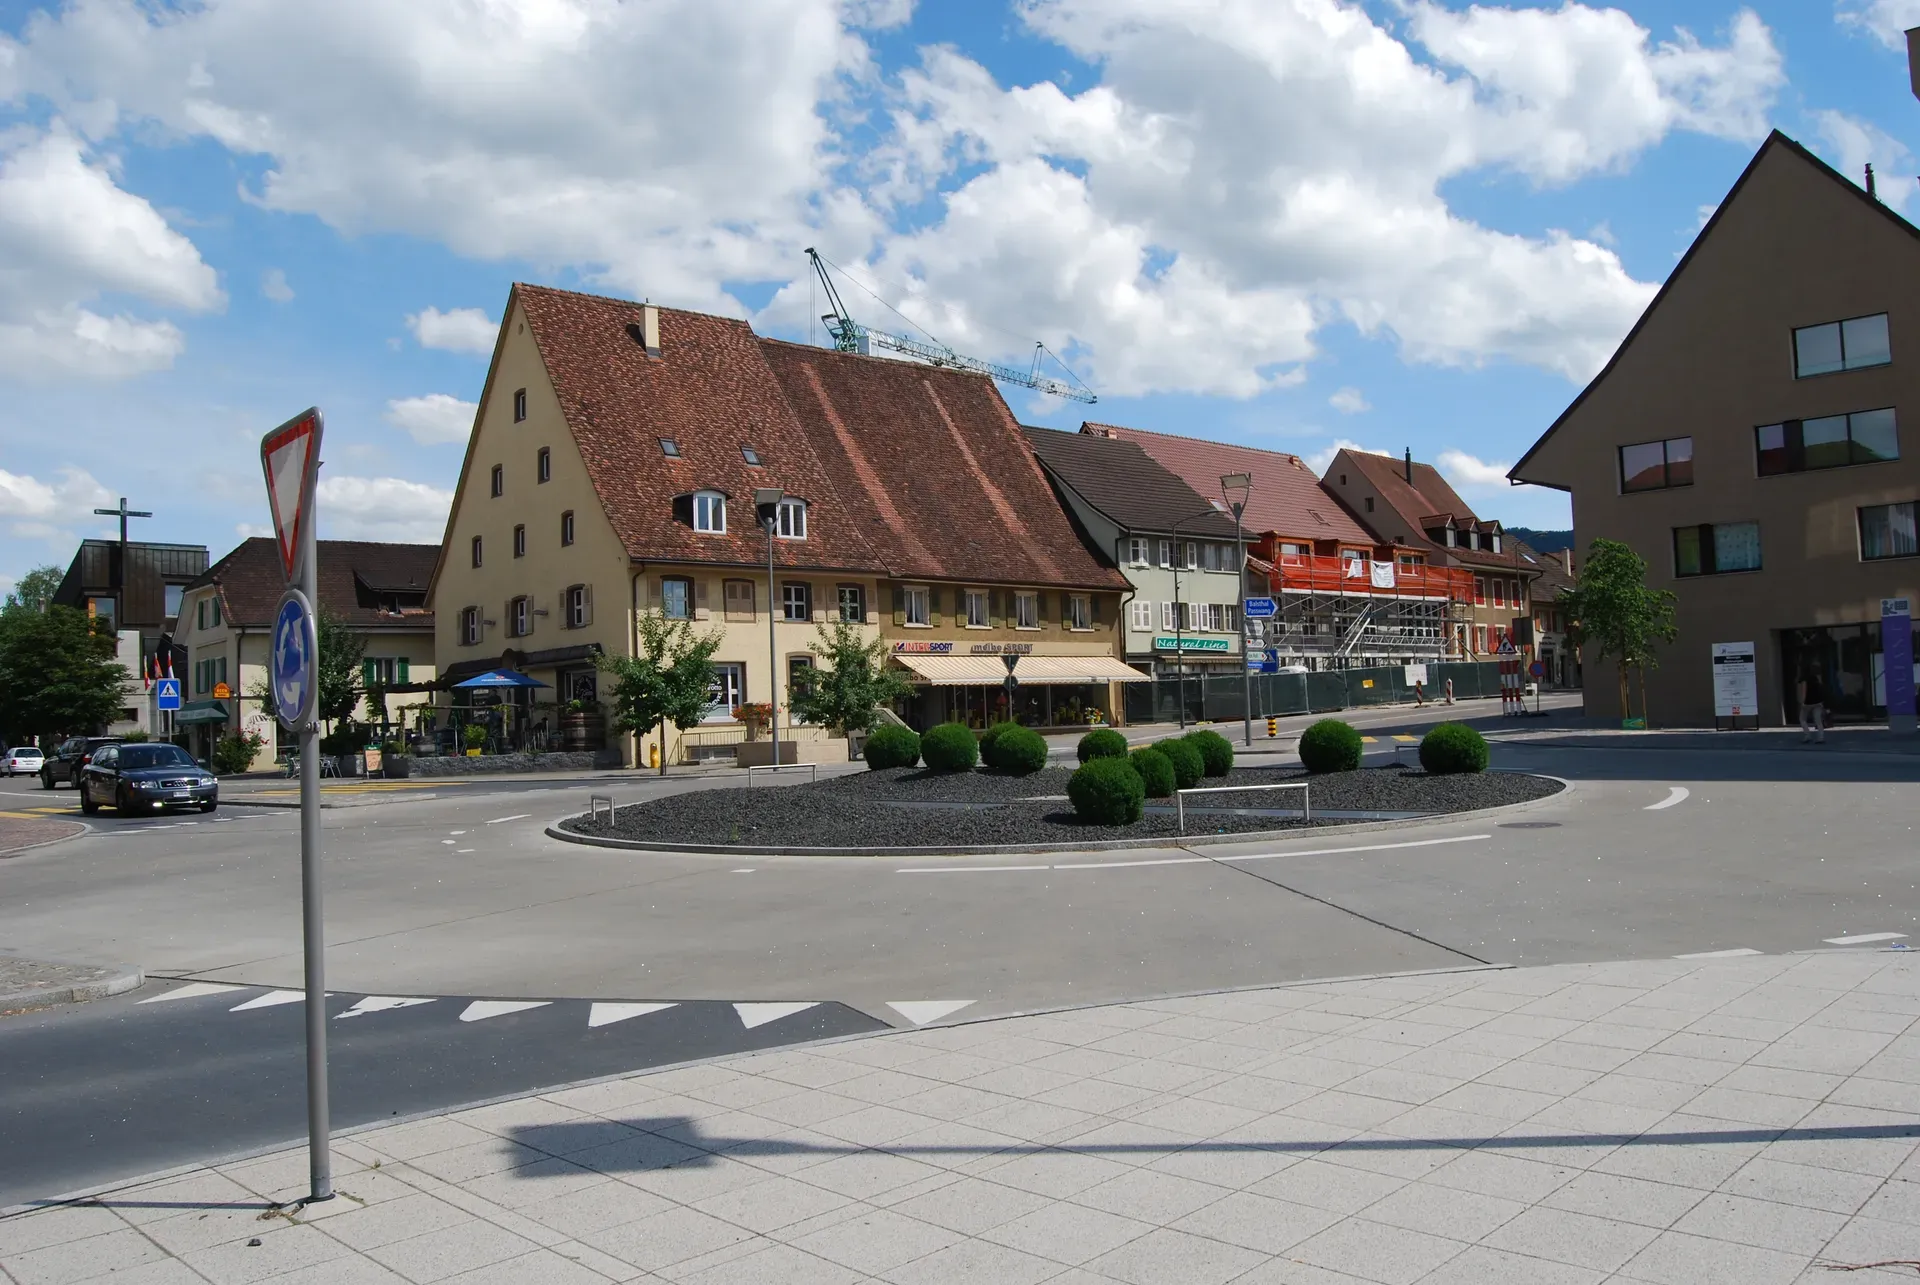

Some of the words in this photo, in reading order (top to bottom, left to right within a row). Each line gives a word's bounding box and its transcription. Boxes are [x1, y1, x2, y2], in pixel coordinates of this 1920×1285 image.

[1247, 607, 1271, 615] Passwang
[905, 642, 953, 652] INTERSPORT
[1005, 643, 1033, 652] SPORT
[1157, 639, 1201, 649] Natural
[1202, 640, 1227, 650] Line
